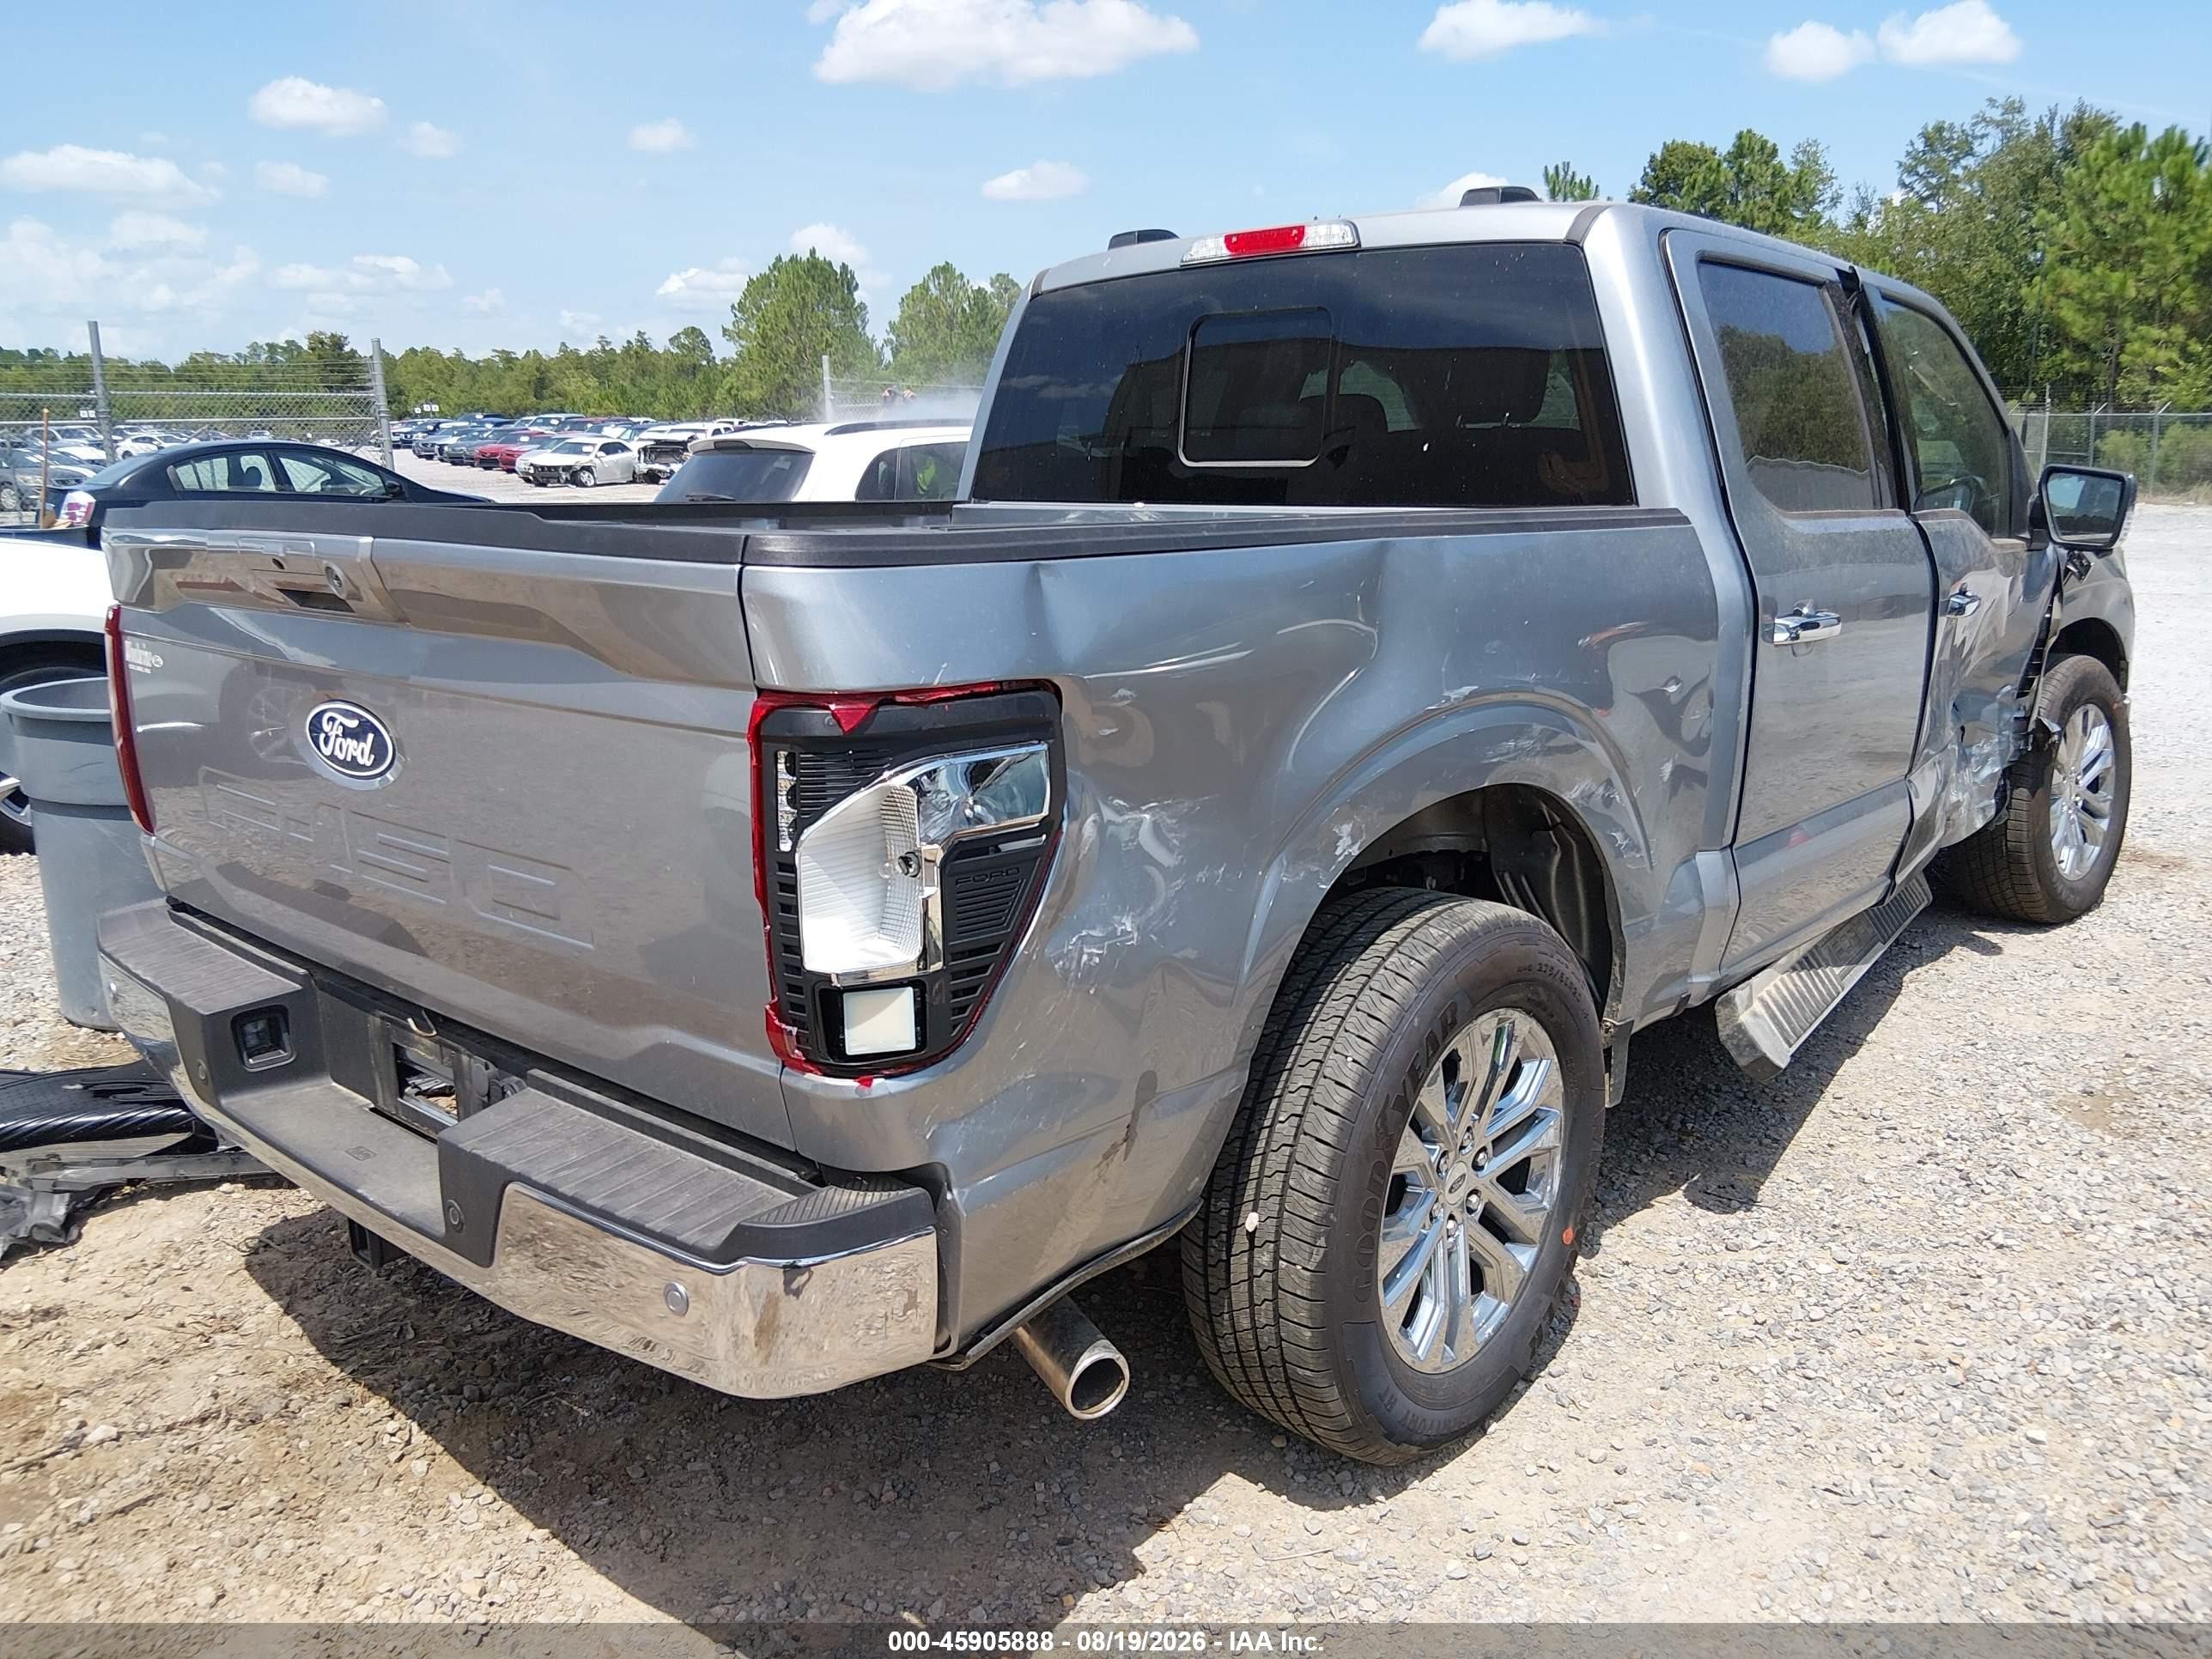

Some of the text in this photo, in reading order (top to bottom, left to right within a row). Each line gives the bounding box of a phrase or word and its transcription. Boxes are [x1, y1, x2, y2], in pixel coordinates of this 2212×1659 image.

[319, 711, 375, 767] Ford
[955, 866, 1020, 888] FORD
[1354, 1000, 1458, 1304] GOODYEAR
